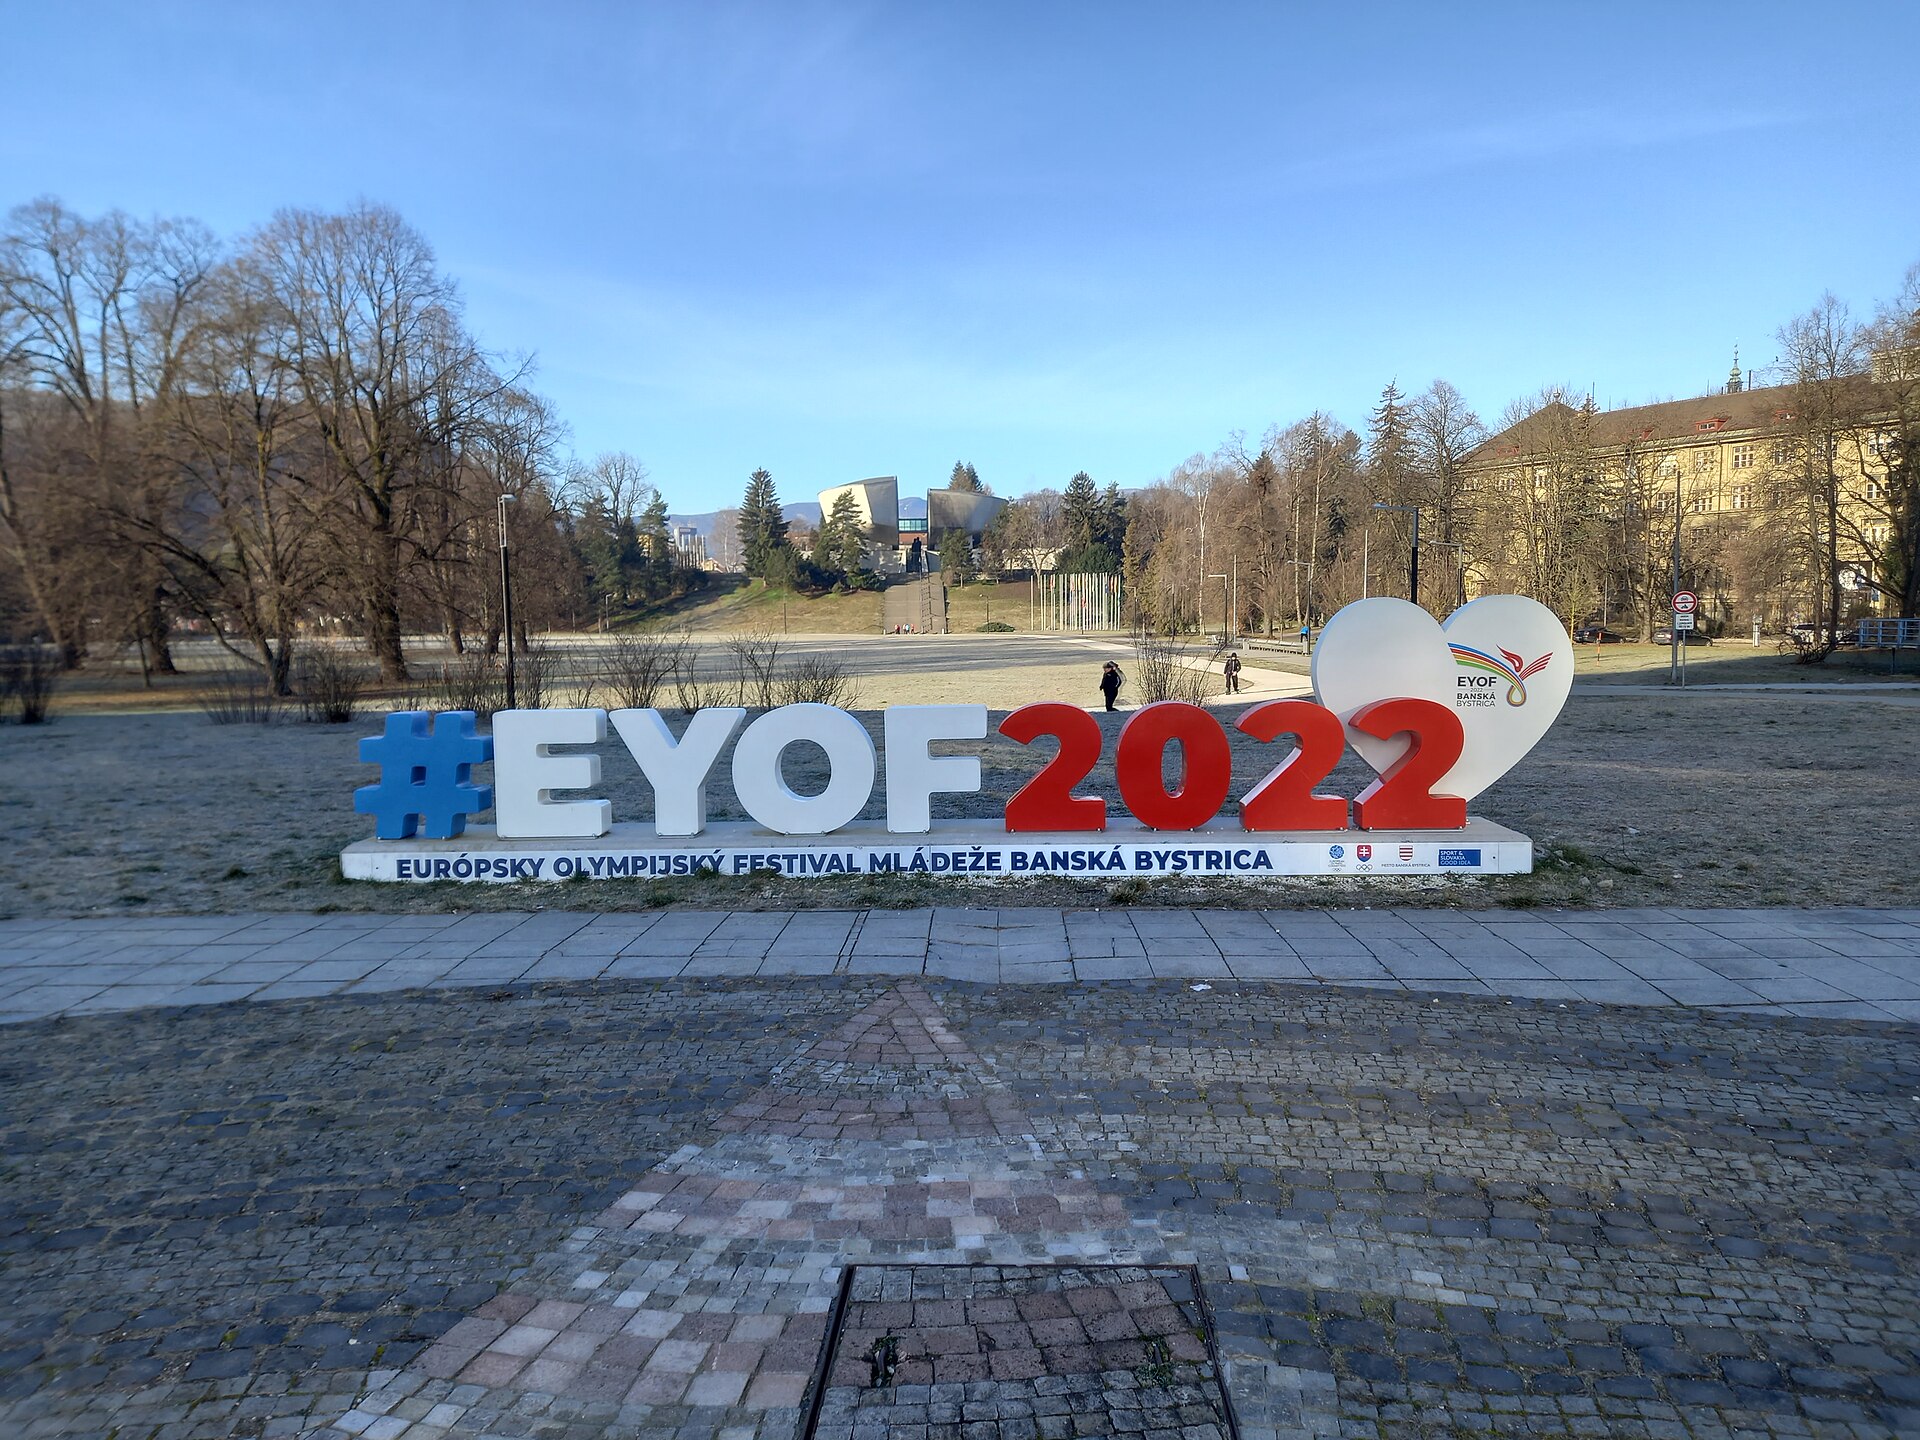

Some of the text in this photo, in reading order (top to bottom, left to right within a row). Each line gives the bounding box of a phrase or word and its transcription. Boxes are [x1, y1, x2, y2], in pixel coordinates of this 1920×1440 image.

[1457, 676, 1497, 687] EYOF
[396, 845, 1273, 878] EURÓPSKY OLYMPIJSKÝ FESTIVAL MLÁDEŽE BANSKÁ BYSTRICA
